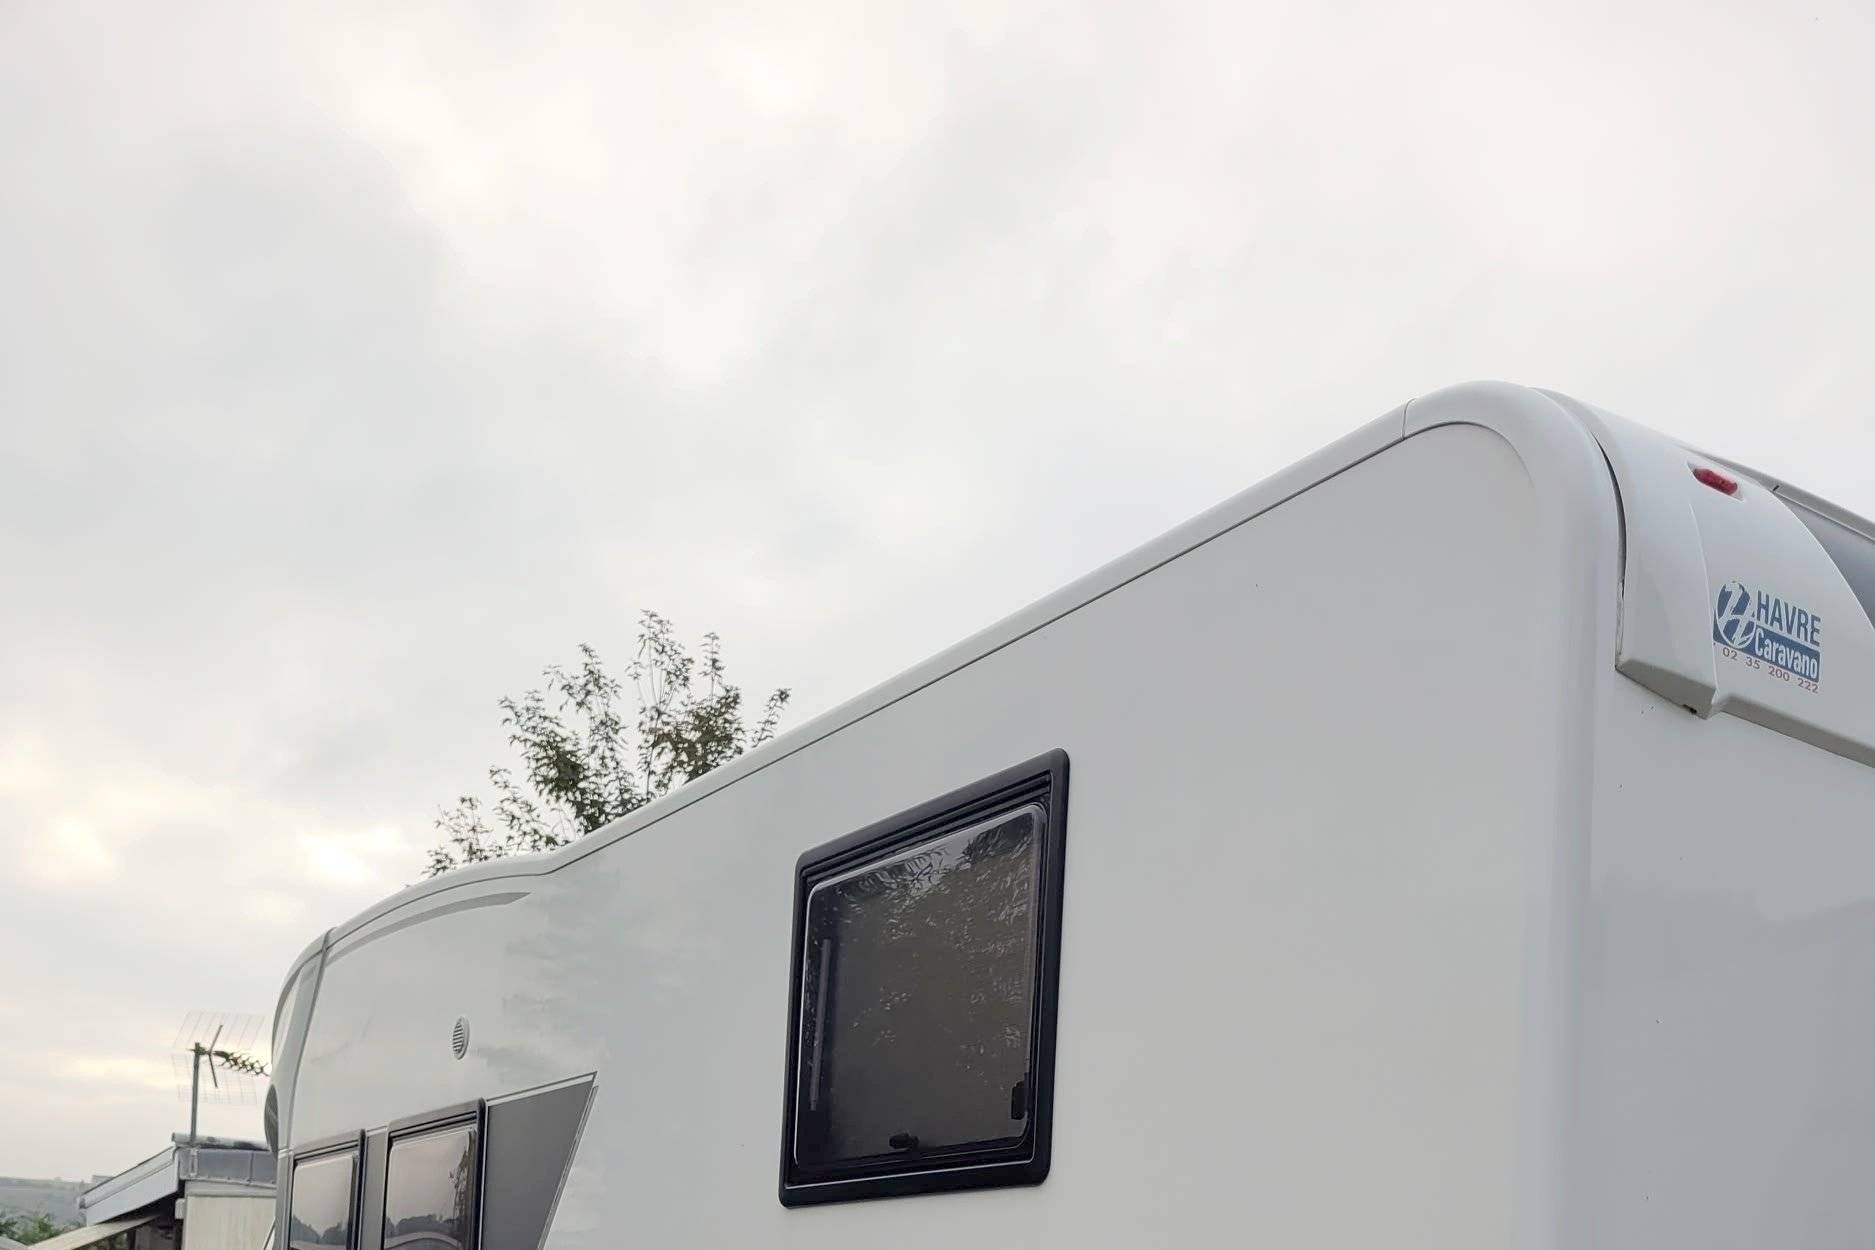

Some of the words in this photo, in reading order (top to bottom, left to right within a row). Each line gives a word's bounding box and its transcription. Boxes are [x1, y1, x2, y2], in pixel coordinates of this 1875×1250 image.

[1757, 590, 1821, 647] HAVRE
[1722, 647, 1738, 660] 02
[1745, 656, 1760, 669] 35
[1768, 665, 1790, 681] 200
[1797, 677, 1819, 693] 222
[1754, 627, 1818, 679] Caravano
